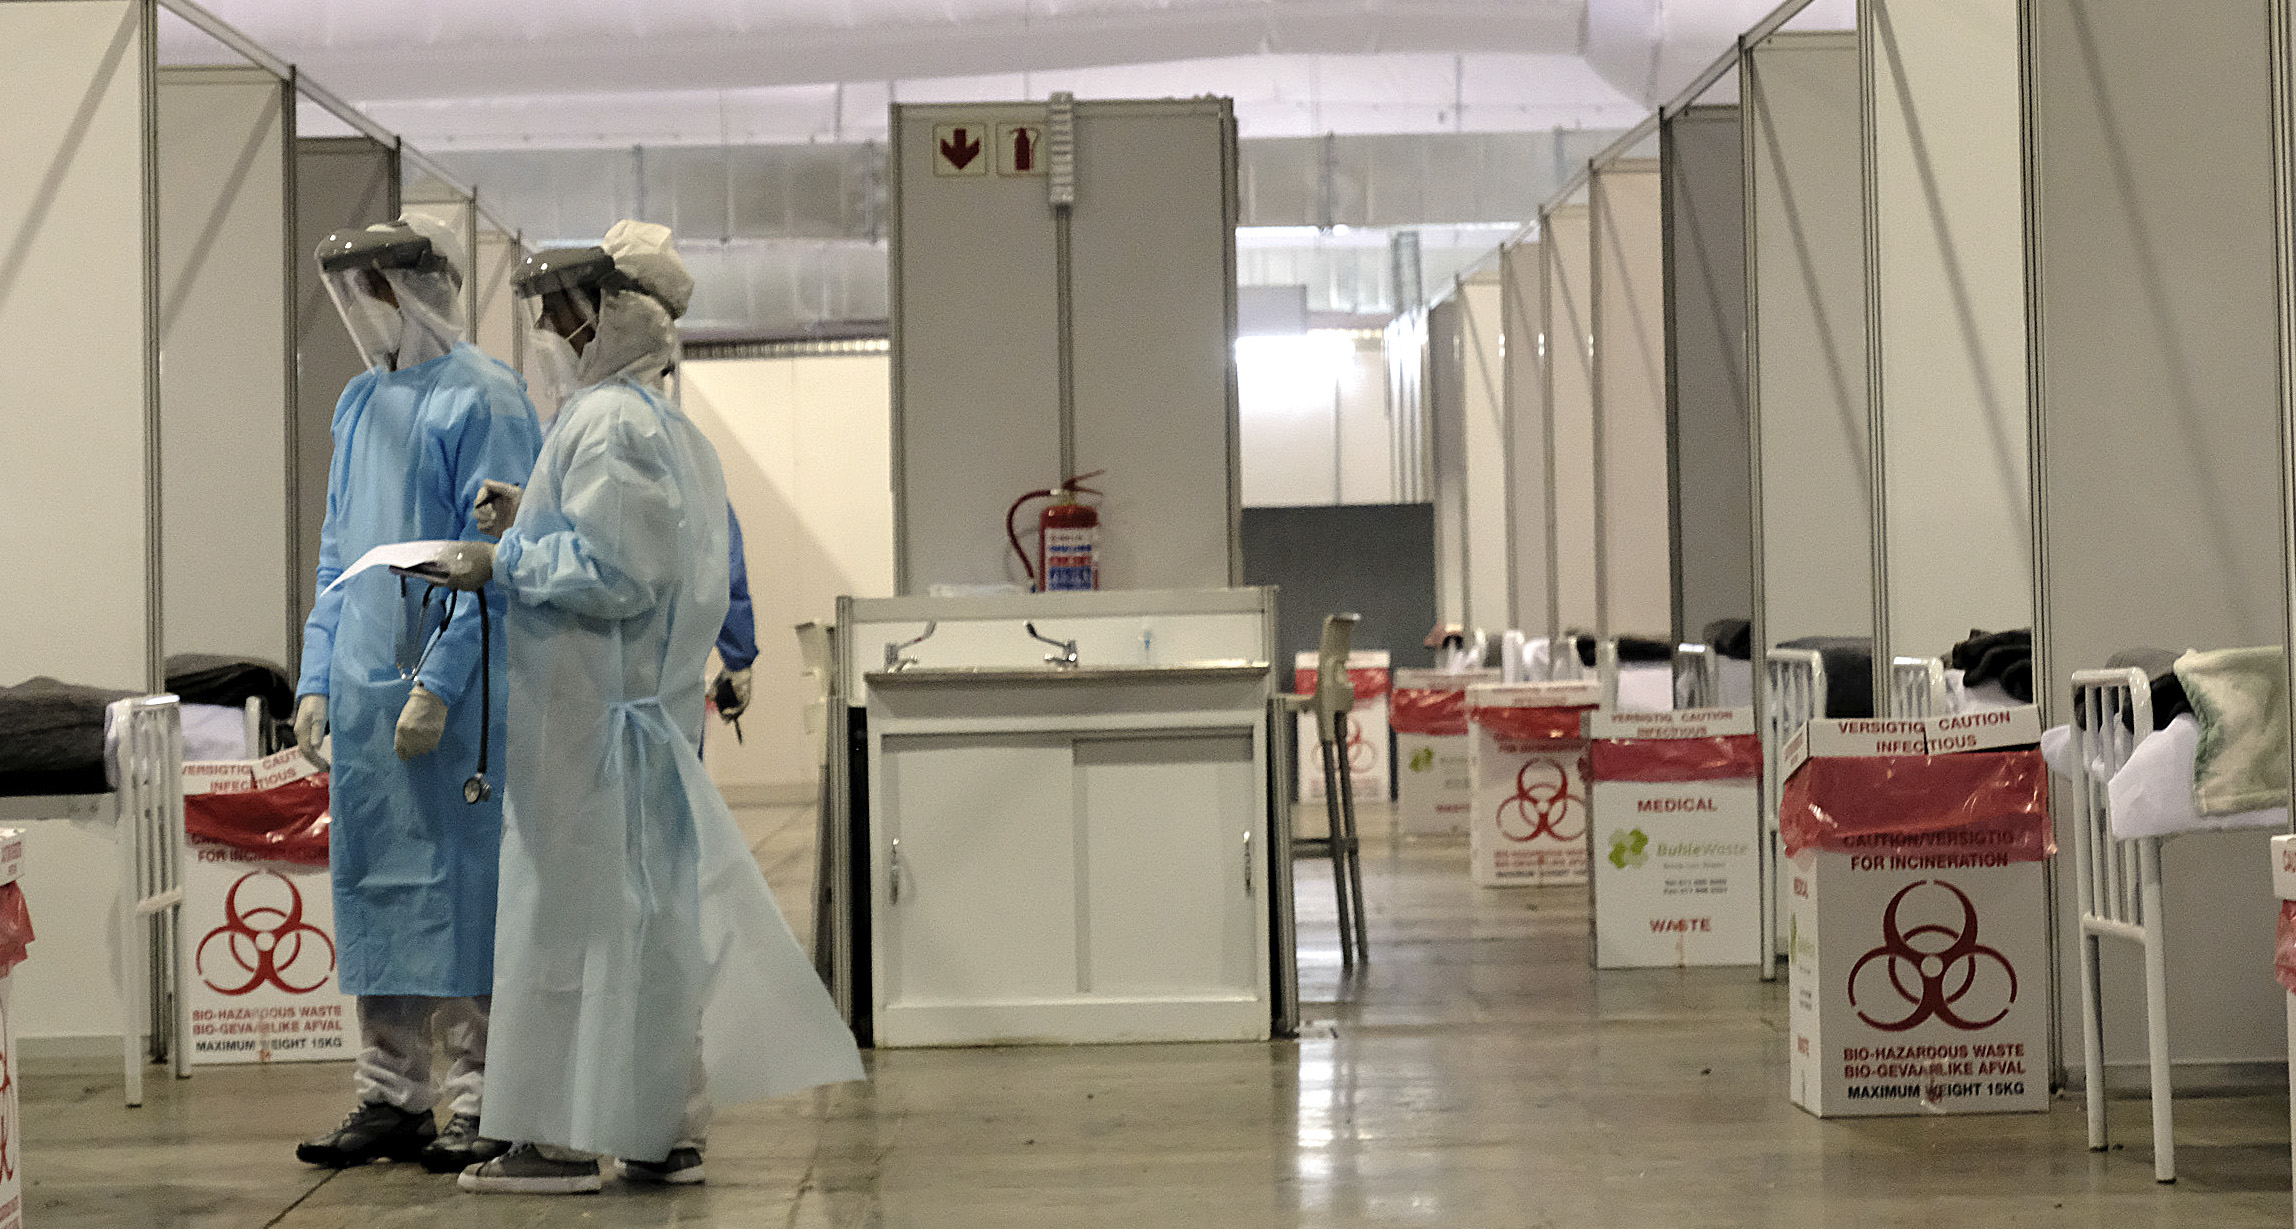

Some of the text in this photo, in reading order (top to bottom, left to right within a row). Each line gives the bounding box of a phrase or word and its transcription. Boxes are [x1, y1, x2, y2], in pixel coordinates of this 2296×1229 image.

[1838, 711, 2011, 734] VERSIGTIG CAUTION
[1876, 734, 1977, 753] INFECTIOUS
[1637, 798, 1718, 813] MEDICAL
[1851, 851, 2009, 872] FOR INCINERATION
[1649, 917, 1711, 932] WASTE
[301, 1005, 342, 1018] WASTE
[303, 1020, 343, 1032] AFVAL
[196, 1039, 256, 1053] MAXIMUM
[312, 1037, 342, 1049] 15KG
[1843, 1043, 2025, 1062] BIO-HAZARDOUS WASTE
[1978, 1060, 2027, 1076] AFVAL
[1847, 1084, 1921, 1099] MAXIMUM
[1987, 1081, 2025, 1096] 15KG
